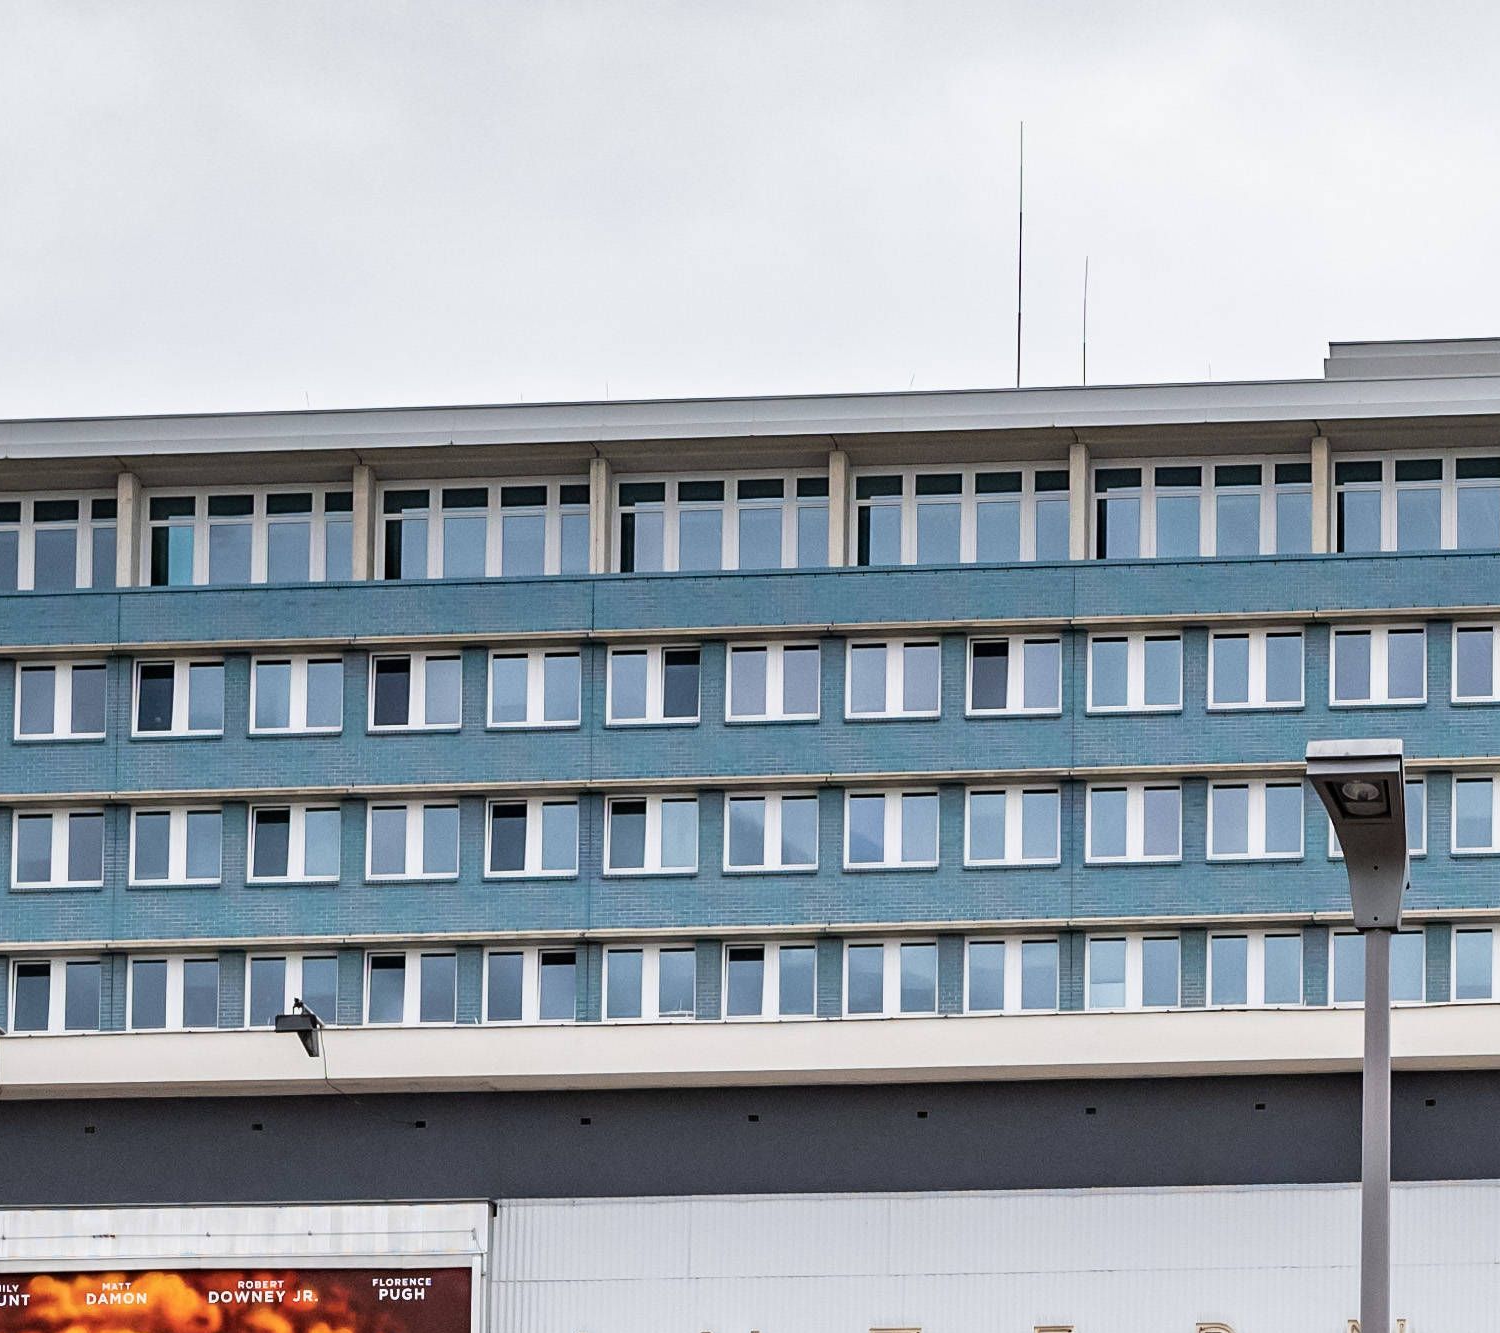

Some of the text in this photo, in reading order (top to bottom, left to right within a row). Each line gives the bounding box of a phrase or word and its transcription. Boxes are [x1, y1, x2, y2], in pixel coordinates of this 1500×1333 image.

[101, 1282, 132, 1292] MATT
[237, 1280, 285, 1289] ROBERT
[372, 1277, 433, 1287] FLORENCE
[86, 1291, 147, 1305] DAMON
[208, 1289, 319, 1304] DOWNEY JR.
[378, 1287, 426, 1301] PUGH
